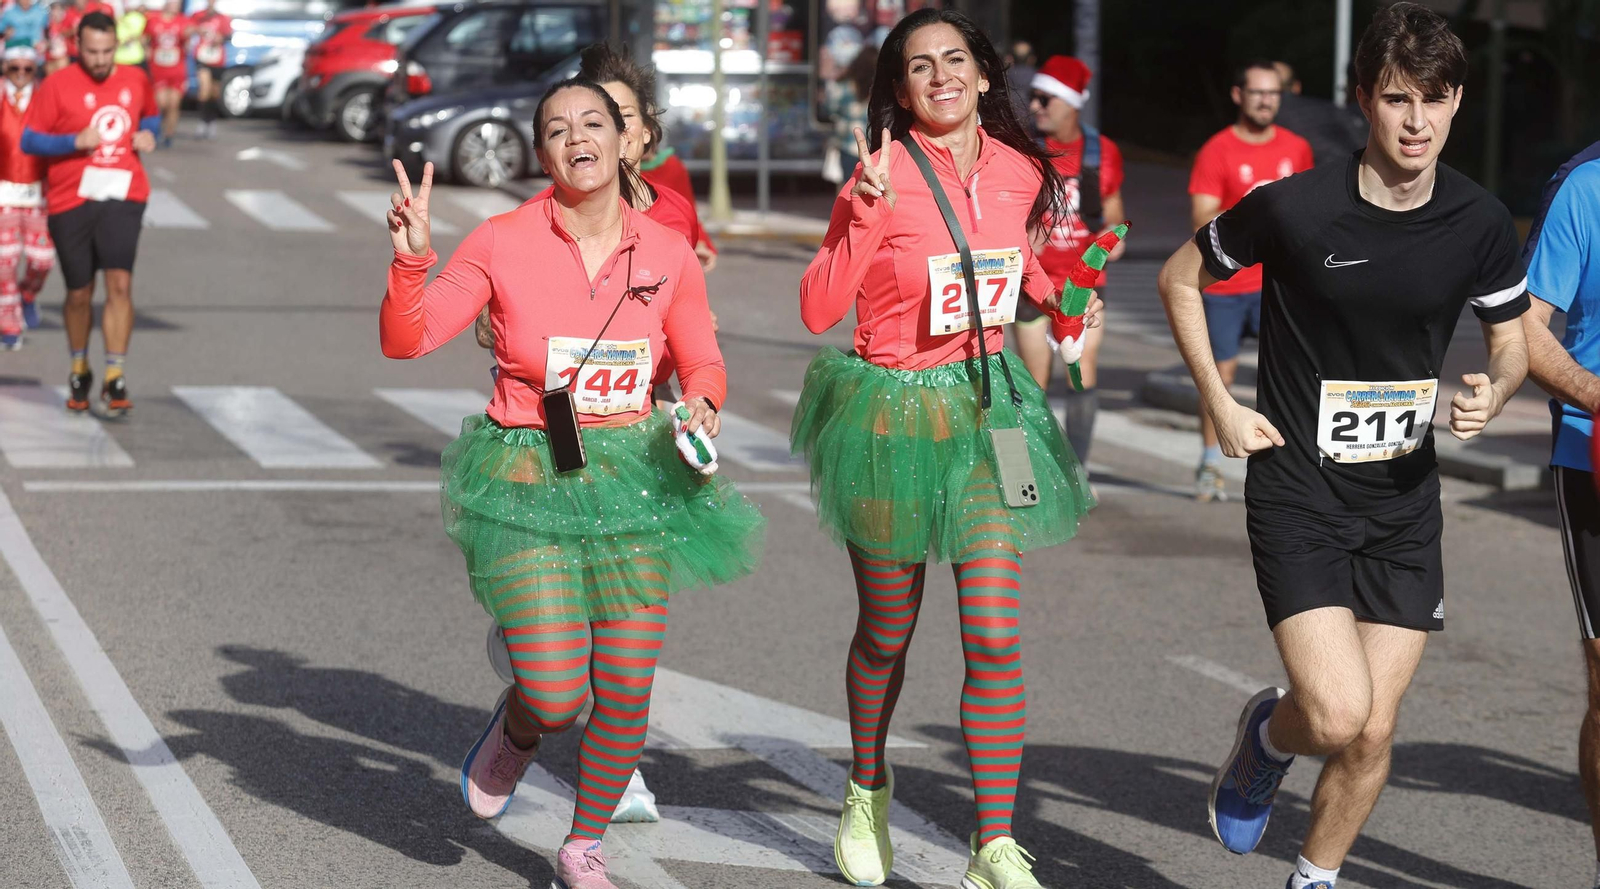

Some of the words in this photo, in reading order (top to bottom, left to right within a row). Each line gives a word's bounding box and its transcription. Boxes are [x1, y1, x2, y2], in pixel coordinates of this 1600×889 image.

[558, 367, 639, 397] 144
[1345, 390, 1381, 402] CARRERA
[1383, 389, 1416, 402] NAVIDAD
[1331, 409, 1417, 442] 211
